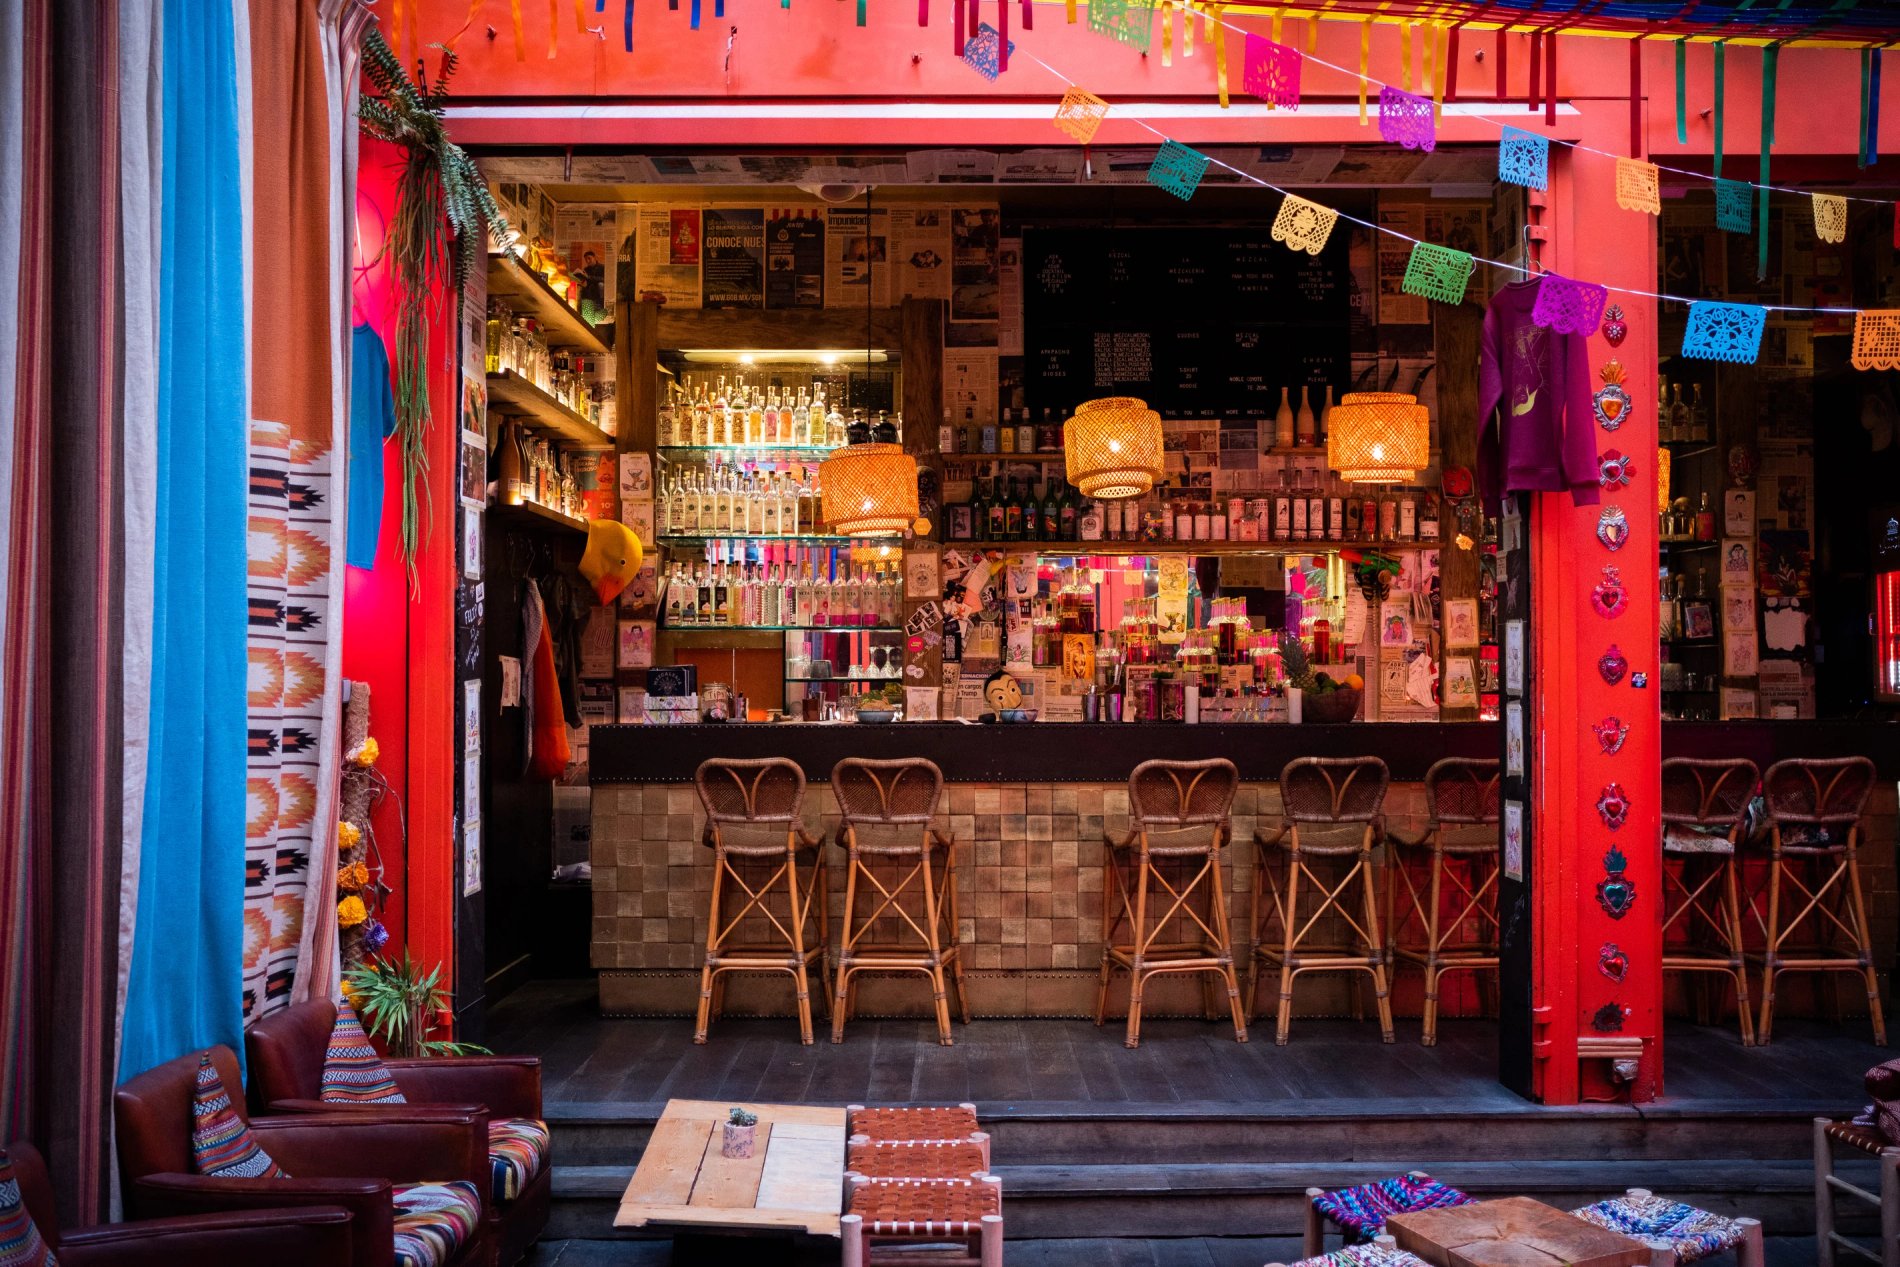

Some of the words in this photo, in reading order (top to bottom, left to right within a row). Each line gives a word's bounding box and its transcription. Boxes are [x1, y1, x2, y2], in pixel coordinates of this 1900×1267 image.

[828, 216, 868, 227] Impunidad
[706, 236, 742, 248] CONOCE
[966, 683, 983, 692] cargos
[961, 690, 979, 699] Trump
